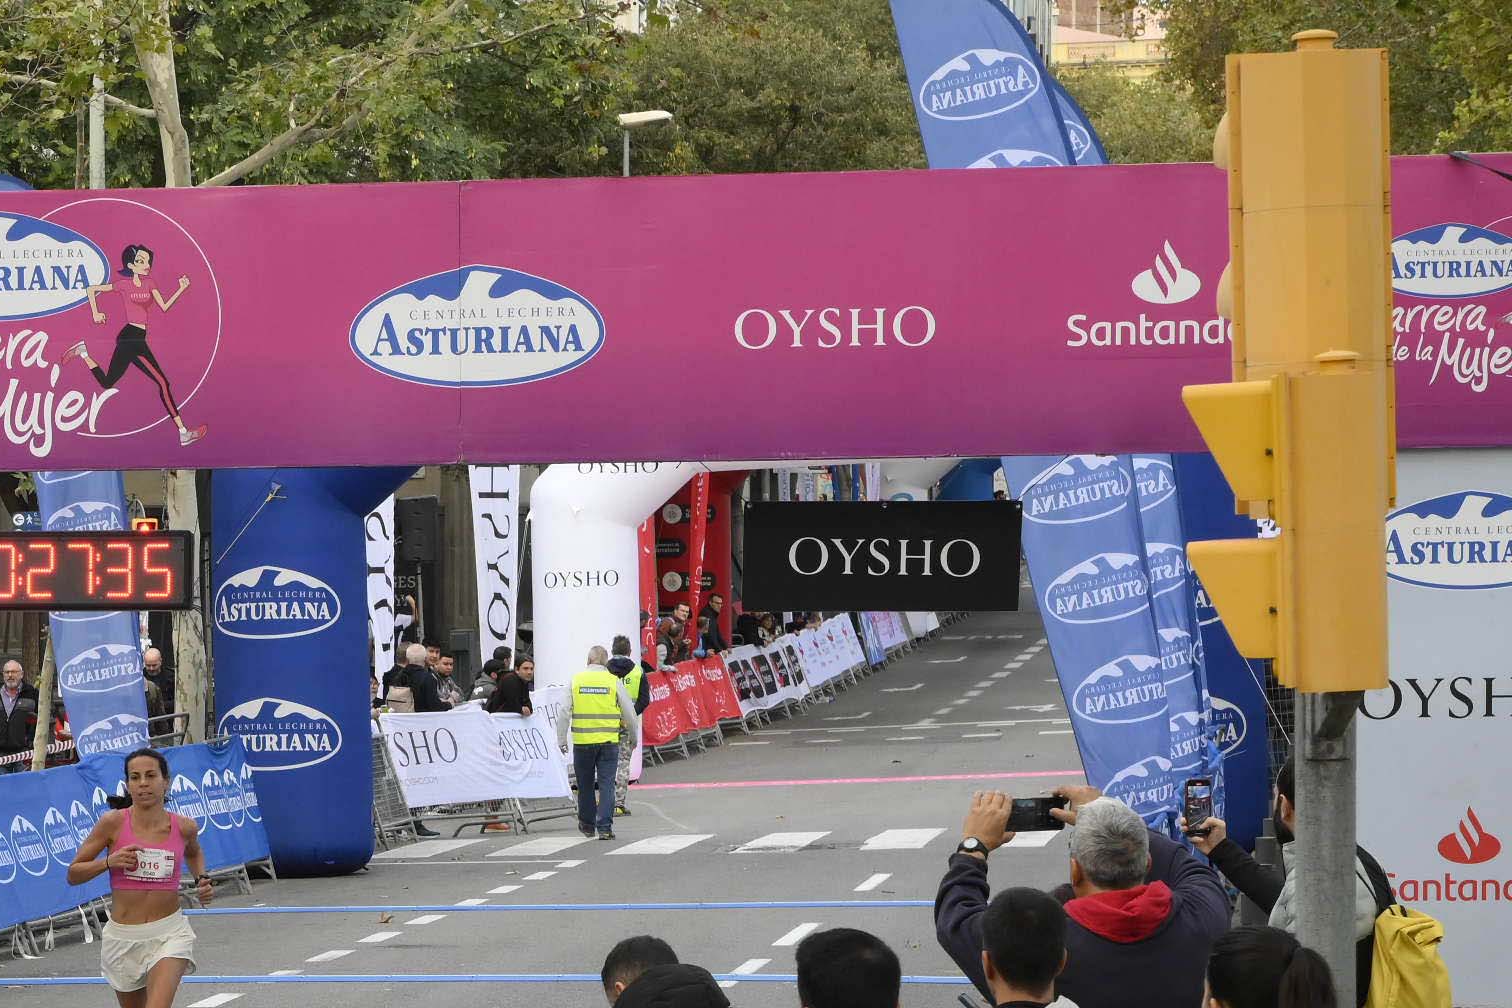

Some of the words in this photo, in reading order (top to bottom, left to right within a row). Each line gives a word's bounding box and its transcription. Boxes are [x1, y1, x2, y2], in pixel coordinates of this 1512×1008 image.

[12, 247, 85, 260] LECHERA
[1406, 248, 1457, 257] CENTRAL
[409, 308, 488, 321] CENTRAL
[496, 306, 577, 319] LECHERA
[1392, 304, 1488, 333] arrera
[370, 313, 585, 357] ASTURIANA
[734, 305, 937, 350] OYSHO
[1067, 314, 1232, 347] Santand
[1415, 333, 1434, 361] la
[1413, 526, 1480, 536] CENTRAL
[789, 536, 981, 577] OYSHO
[544, 570, 619, 589] OYSHO
[231, 591, 273, 600] CENTRAL
[278, 590, 327, 599] LECHERA
[219, 595, 331, 623] ASTURIANA
[233, 723, 274, 731] CENTRAL
[279, 722, 328, 731] LECHERA
[224, 727, 332, 752] TURIANA
